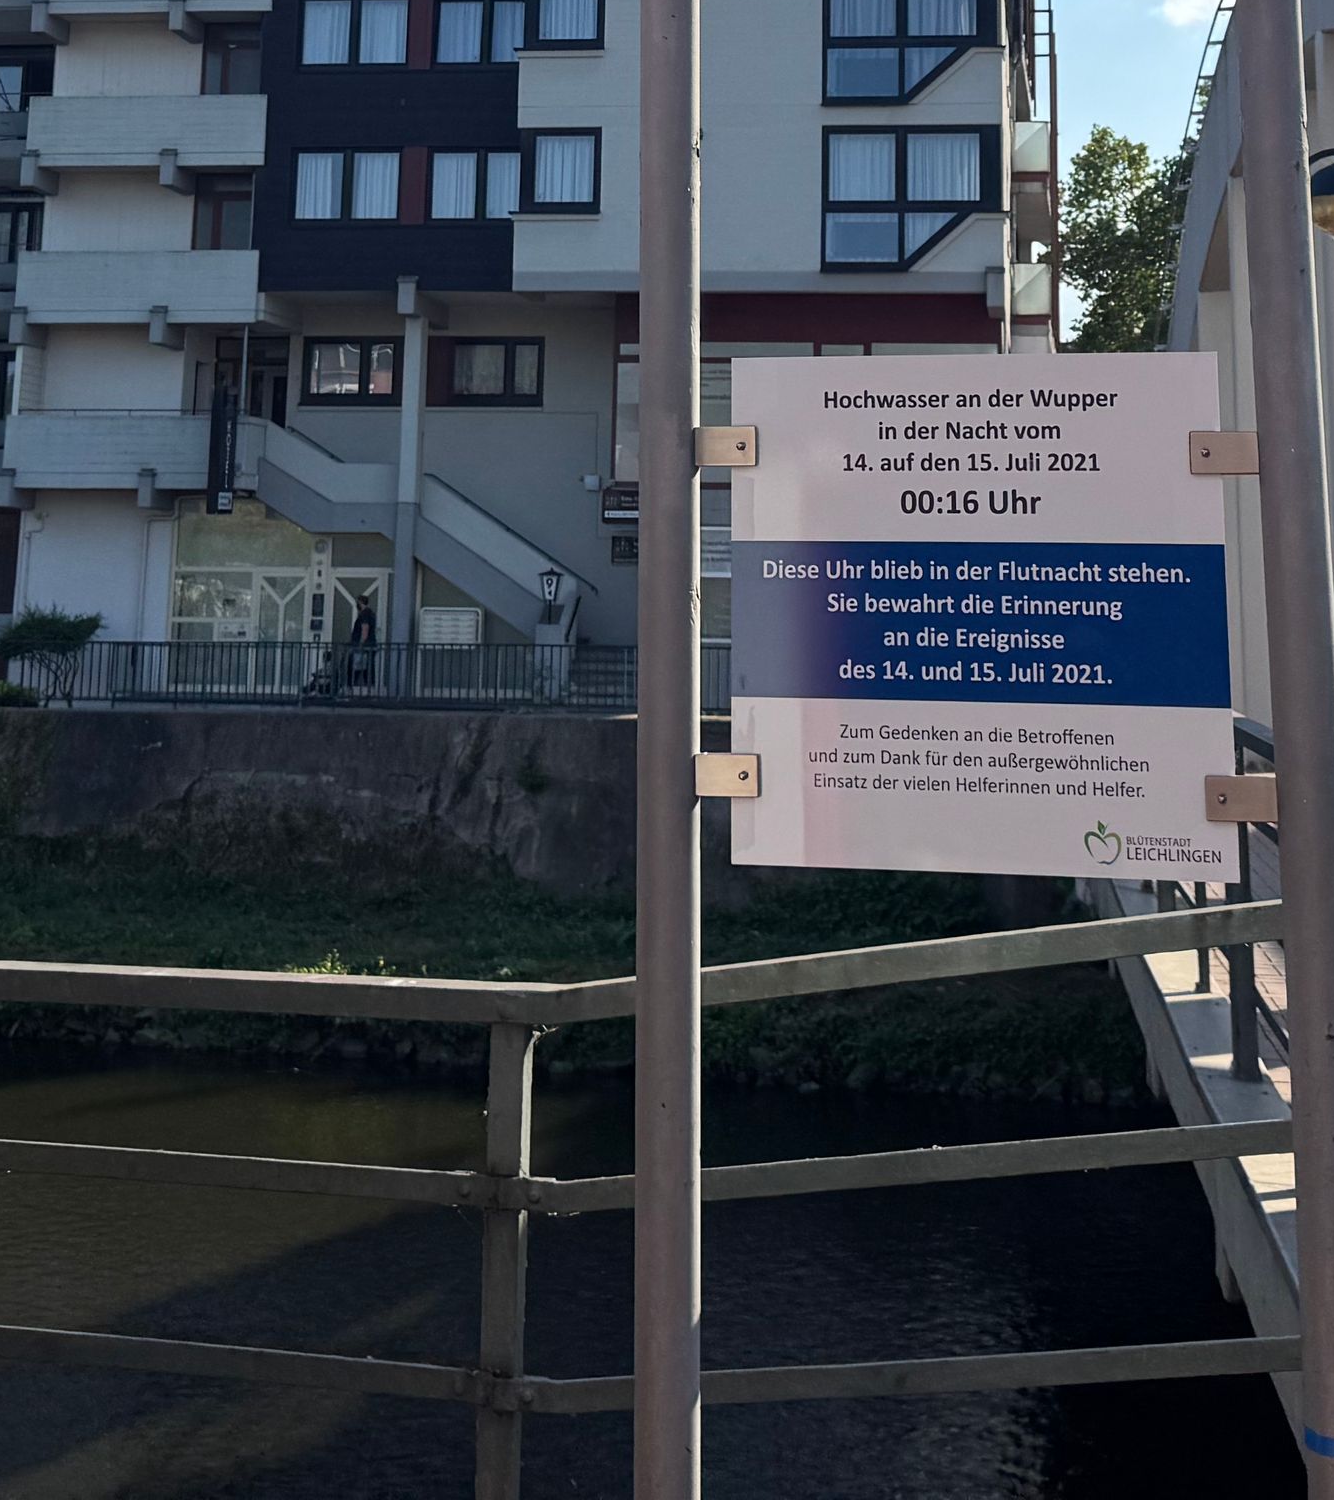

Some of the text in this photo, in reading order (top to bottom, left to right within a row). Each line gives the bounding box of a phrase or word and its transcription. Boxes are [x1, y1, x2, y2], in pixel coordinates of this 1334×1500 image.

[824, 388, 1118, 412] Hochwasser an der Wupper
[878, 419, 1061, 440] in der Nacht vom
[843, 451, 1101, 472] 14. auf den 15. Juli 2021
[900, 488, 1042, 515] 00:16 Uhr
[763, 559, 1191, 583] Diese Uhr blieb in der Flutnacht stehen.
[827, 592, 1123, 621] Sie bewahrt die Erinnerung
[883, 626, 1065, 653] an die Ereignisse
[839, 658, 1113, 685] des 14. und 15. Juli 2021.
[839, 723, 1115, 746] Zum Gedenken an die Betroffenen
[808, 747, 1150, 773] und zum Dank für den außergewöhnlichen
[814, 773, 1146, 798] Einsatz der vielen Helferinnen und Helfer.
[1125, 835, 1191, 848] BLÜTENSTADT
[1126, 846, 1222, 864] LEICHLINGEN
